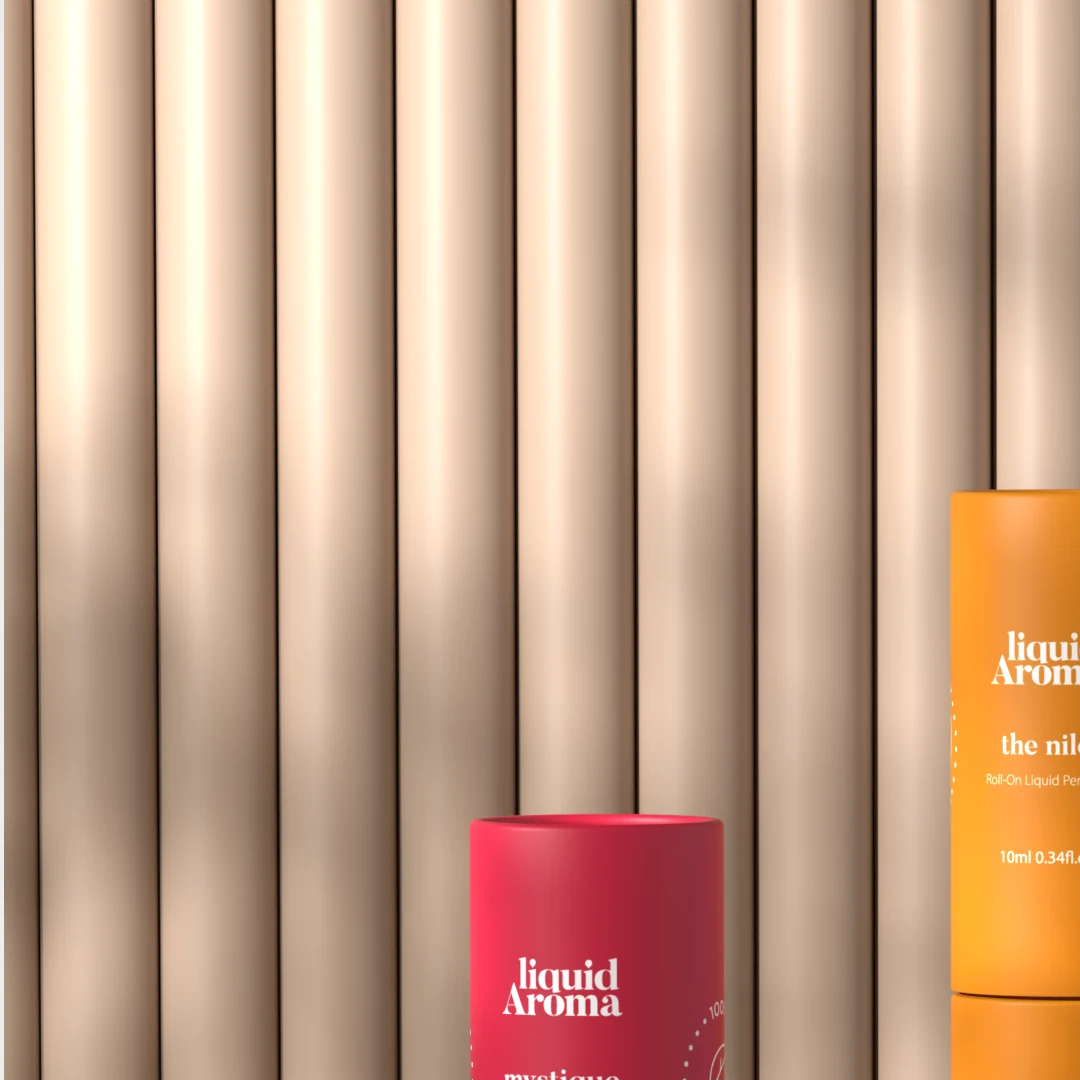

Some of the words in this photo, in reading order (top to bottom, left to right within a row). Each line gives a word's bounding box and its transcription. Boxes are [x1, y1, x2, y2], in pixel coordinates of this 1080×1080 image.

[1001, 732, 1038, 755] the
[985, 773, 1022, 786] Roll-On
[1025, 774, 1060, 788] Liquid
[1000, 850, 1032, 864] 10ml
[518, 956, 619, 993] liquid
[502, 982, 623, 1017] Aroma
